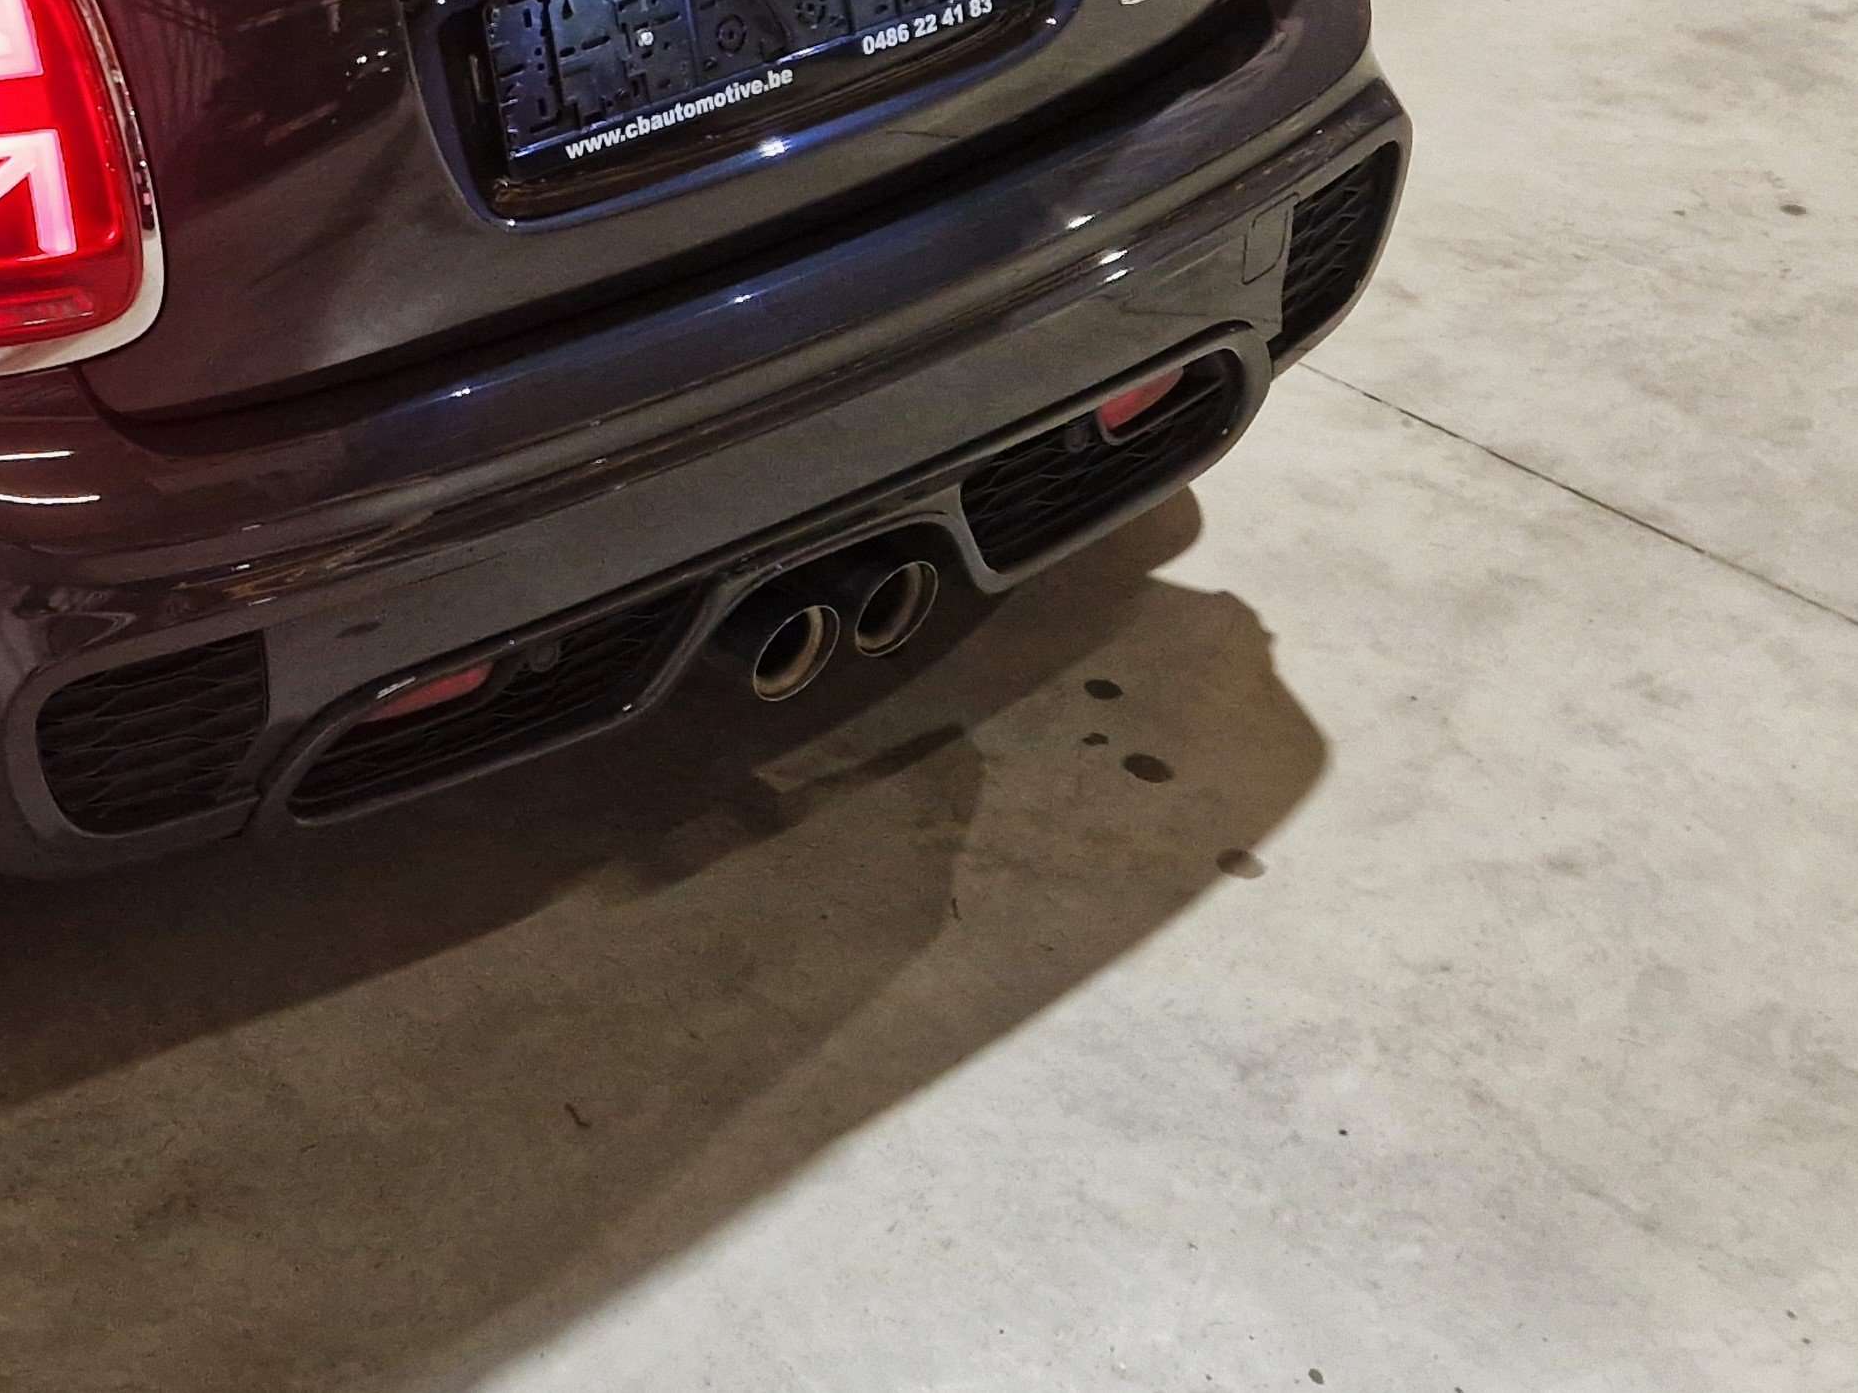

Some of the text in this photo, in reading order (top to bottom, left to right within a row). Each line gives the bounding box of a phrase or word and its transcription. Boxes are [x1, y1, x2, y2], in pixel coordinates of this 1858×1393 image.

[862, 23, 910, 55] 0486
[913, 14, 938, 38] 22
[942, 3, 964, 26] 41
[565, 69, 794, 159] www.cbautomotive.be
